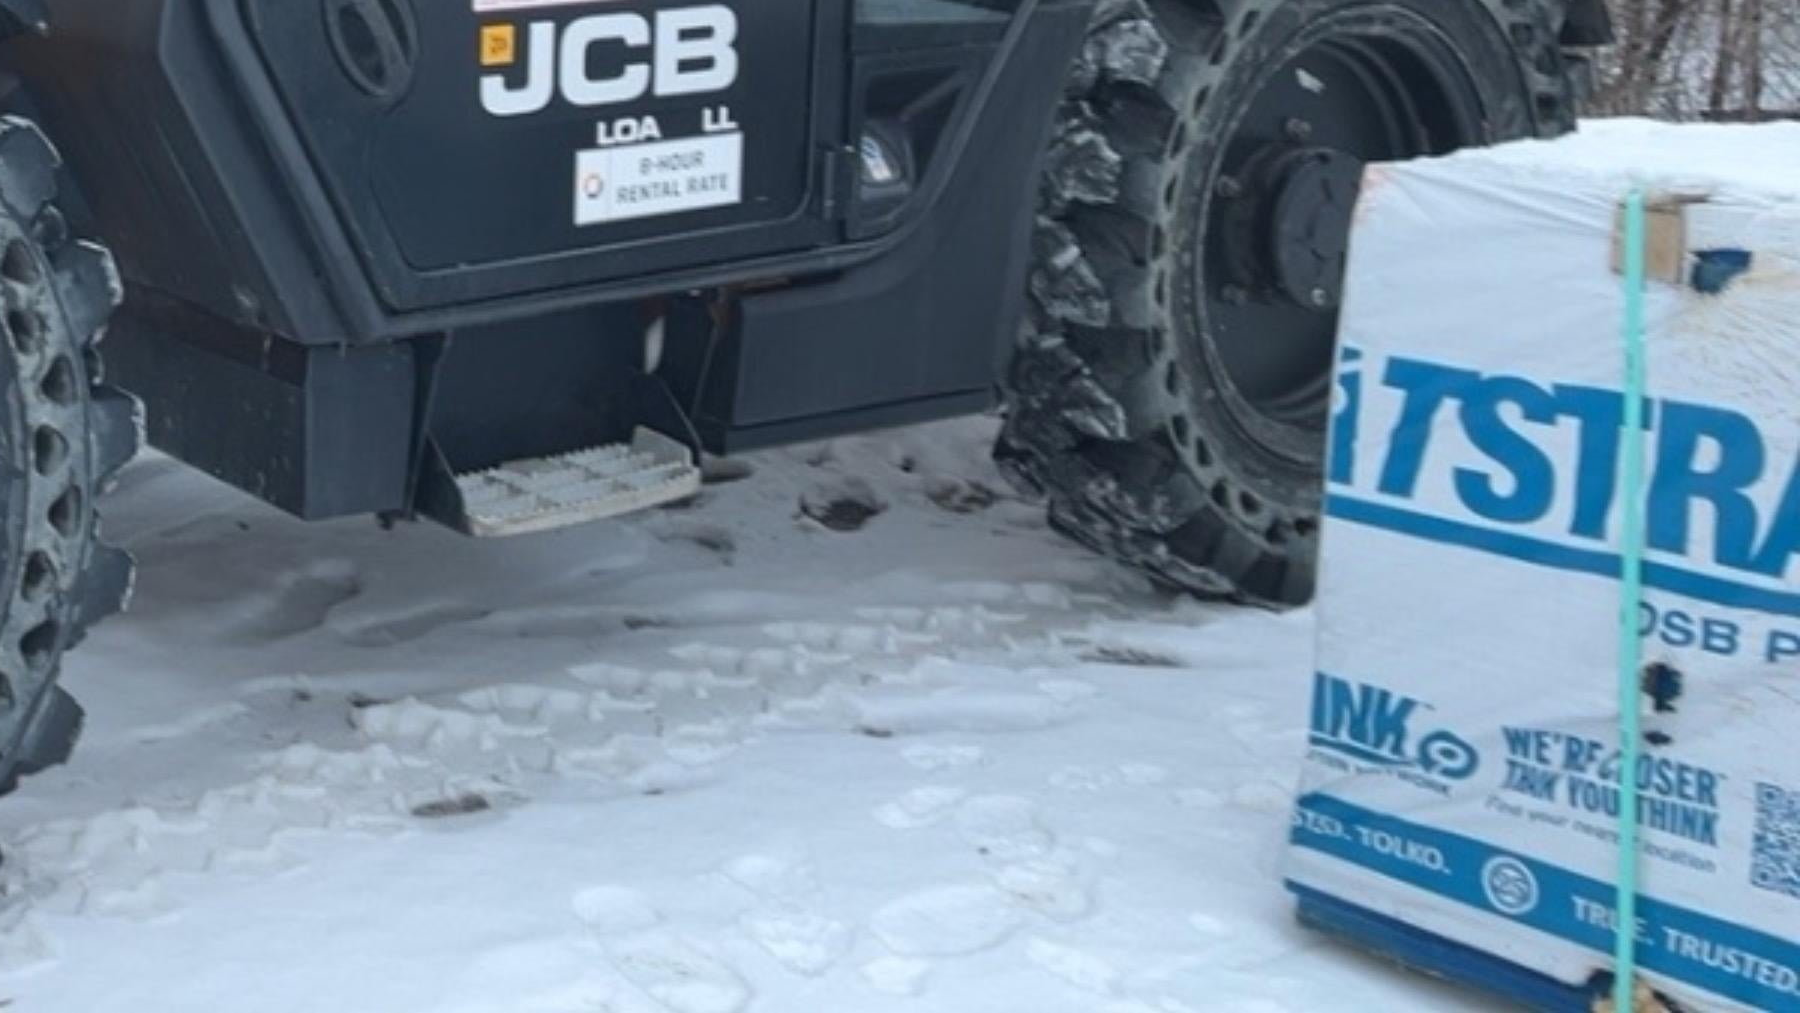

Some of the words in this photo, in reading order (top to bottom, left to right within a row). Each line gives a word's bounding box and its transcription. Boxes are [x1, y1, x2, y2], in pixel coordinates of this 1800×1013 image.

[480, 4, 739, 117] JCB
[615, 180, 682, 205] RENTAL
[686, 172, 729, 194] RATE
[1566, 774, 1622, 819] YOU
[1634, 794, 1718, 848] THINK
